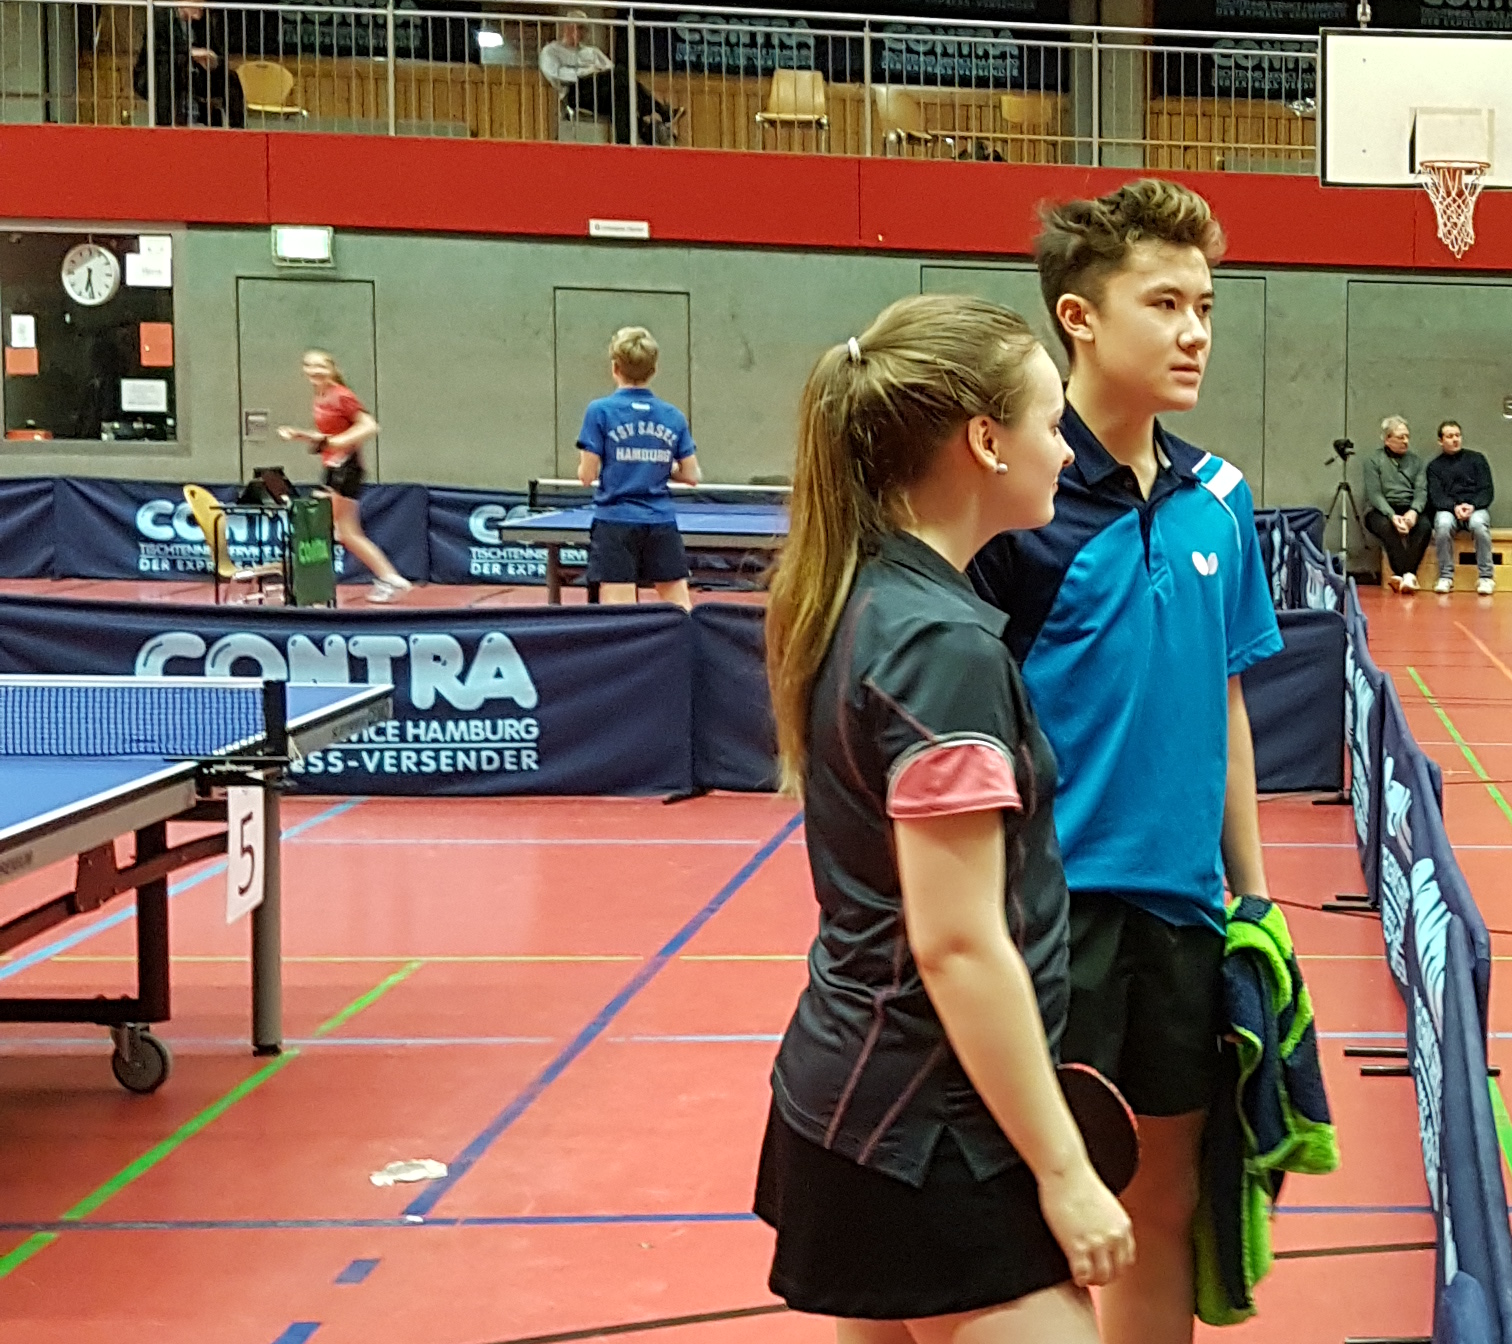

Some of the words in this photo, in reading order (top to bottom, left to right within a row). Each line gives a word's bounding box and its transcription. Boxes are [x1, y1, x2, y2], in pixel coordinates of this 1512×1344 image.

[470, 563, 502, 576] DER
[406, 718, 540, 743] HAMBURG
[238, 811, 255, 895] 5
